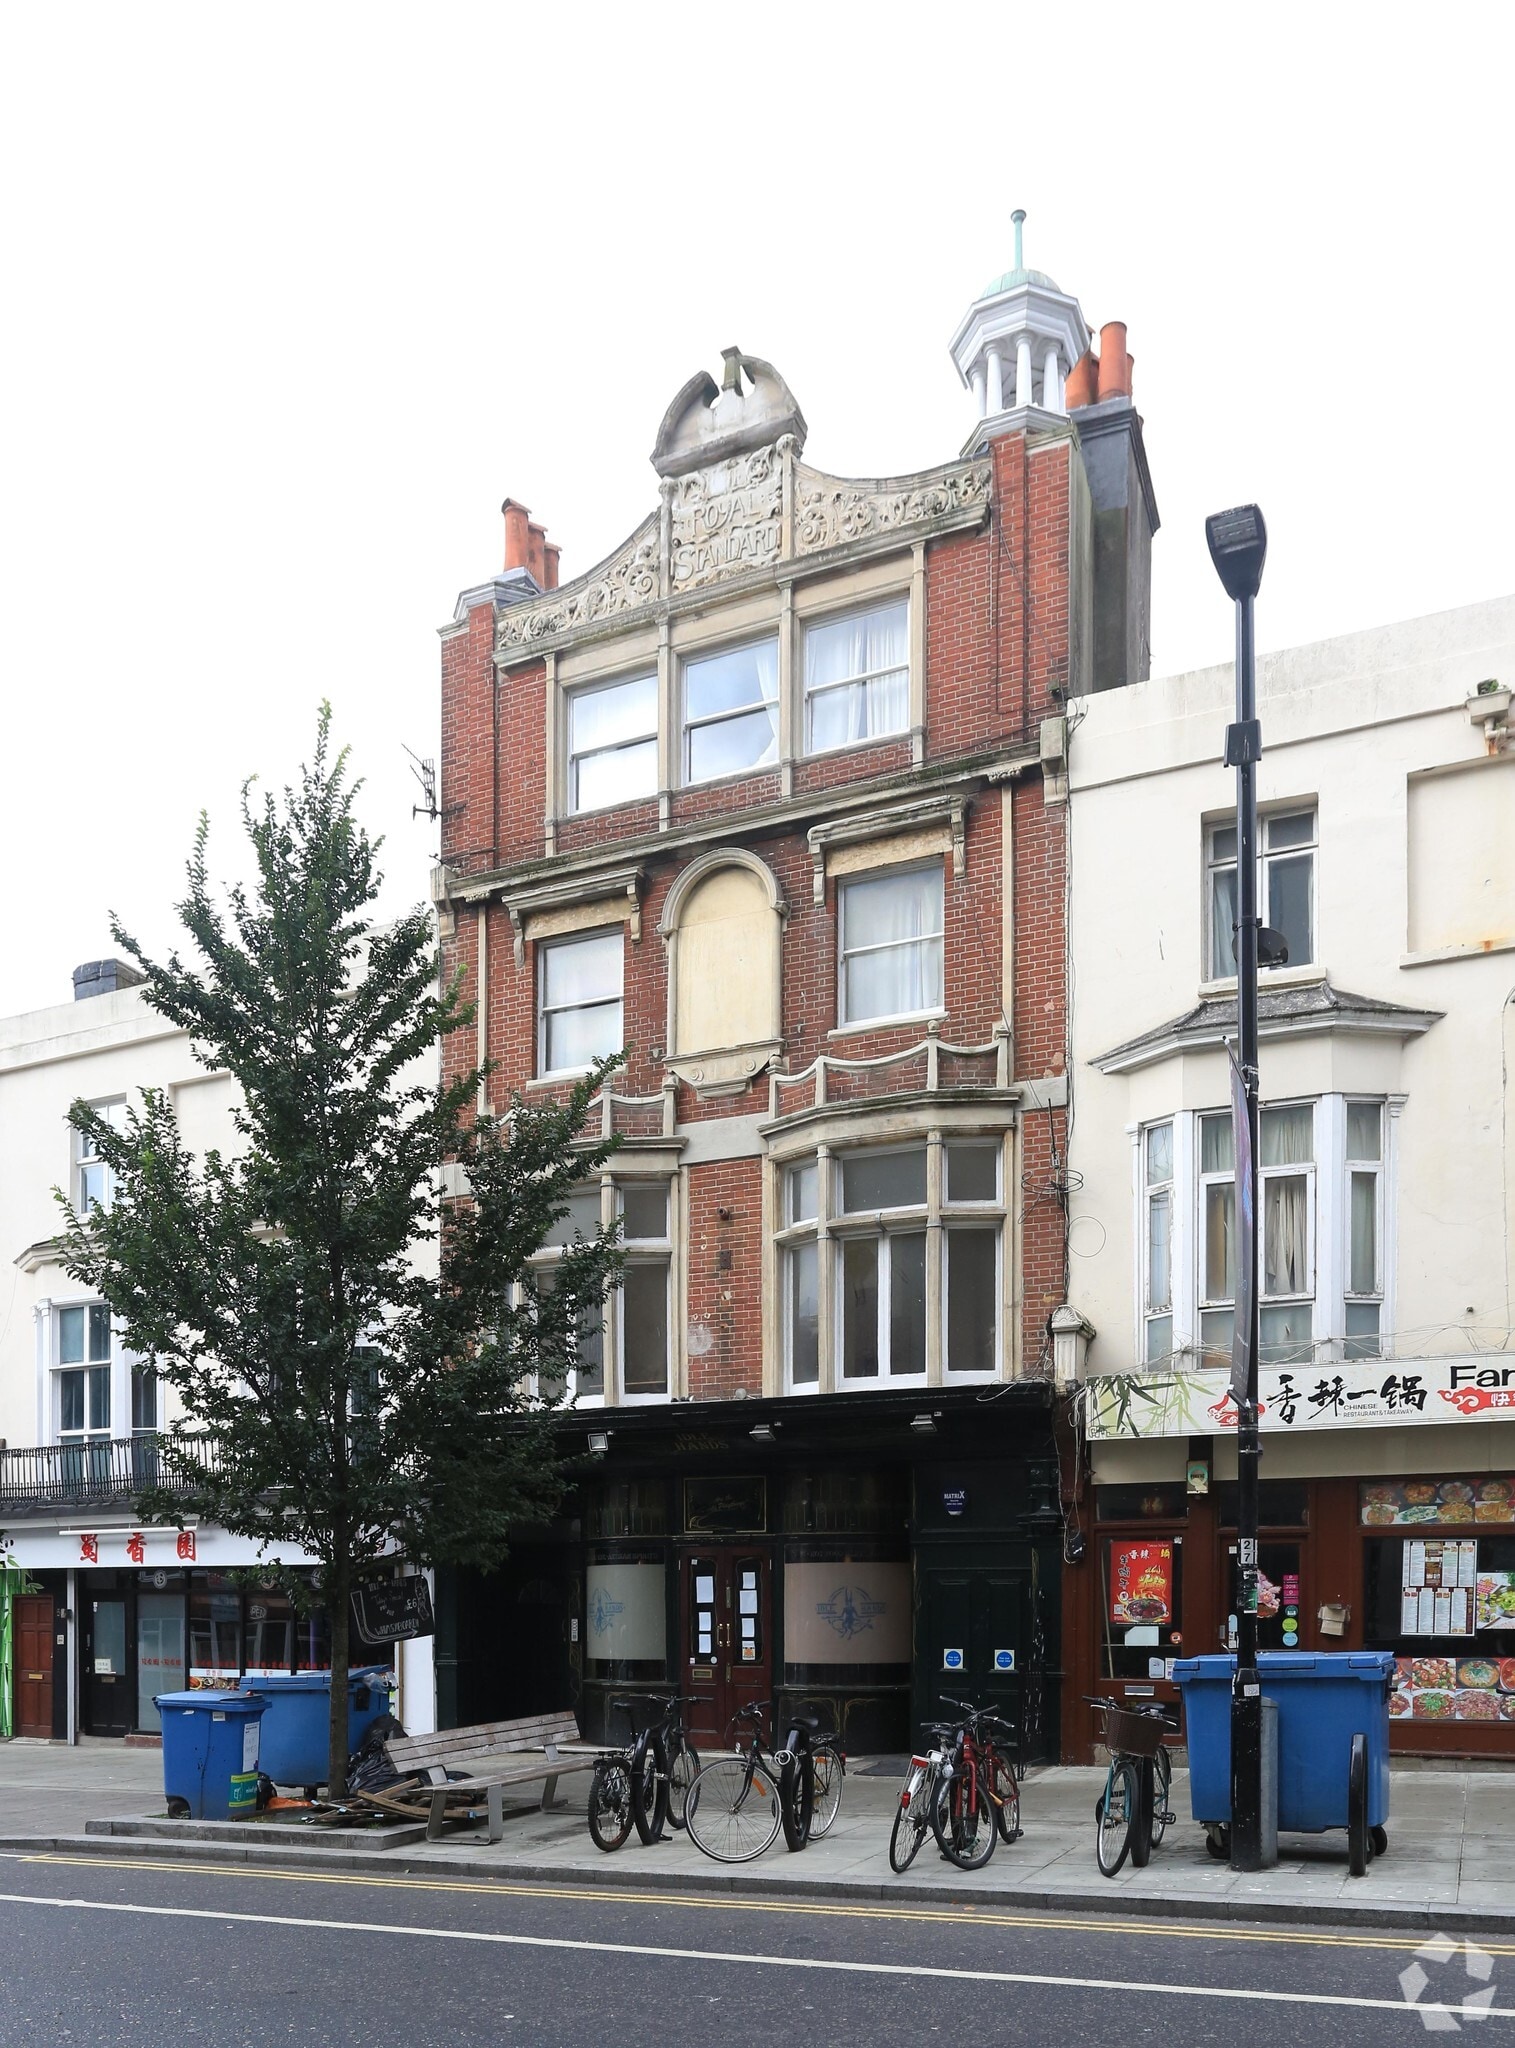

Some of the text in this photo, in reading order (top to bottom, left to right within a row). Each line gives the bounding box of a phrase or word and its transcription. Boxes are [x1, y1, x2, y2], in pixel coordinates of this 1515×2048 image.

[693, 493, 761, 538] ROYAL
[671, 526, 778, 580] STANDARD
[1343, 1403, 1378, 1411] CHINESE
[1490, 1392, 1515, 1407] 快
